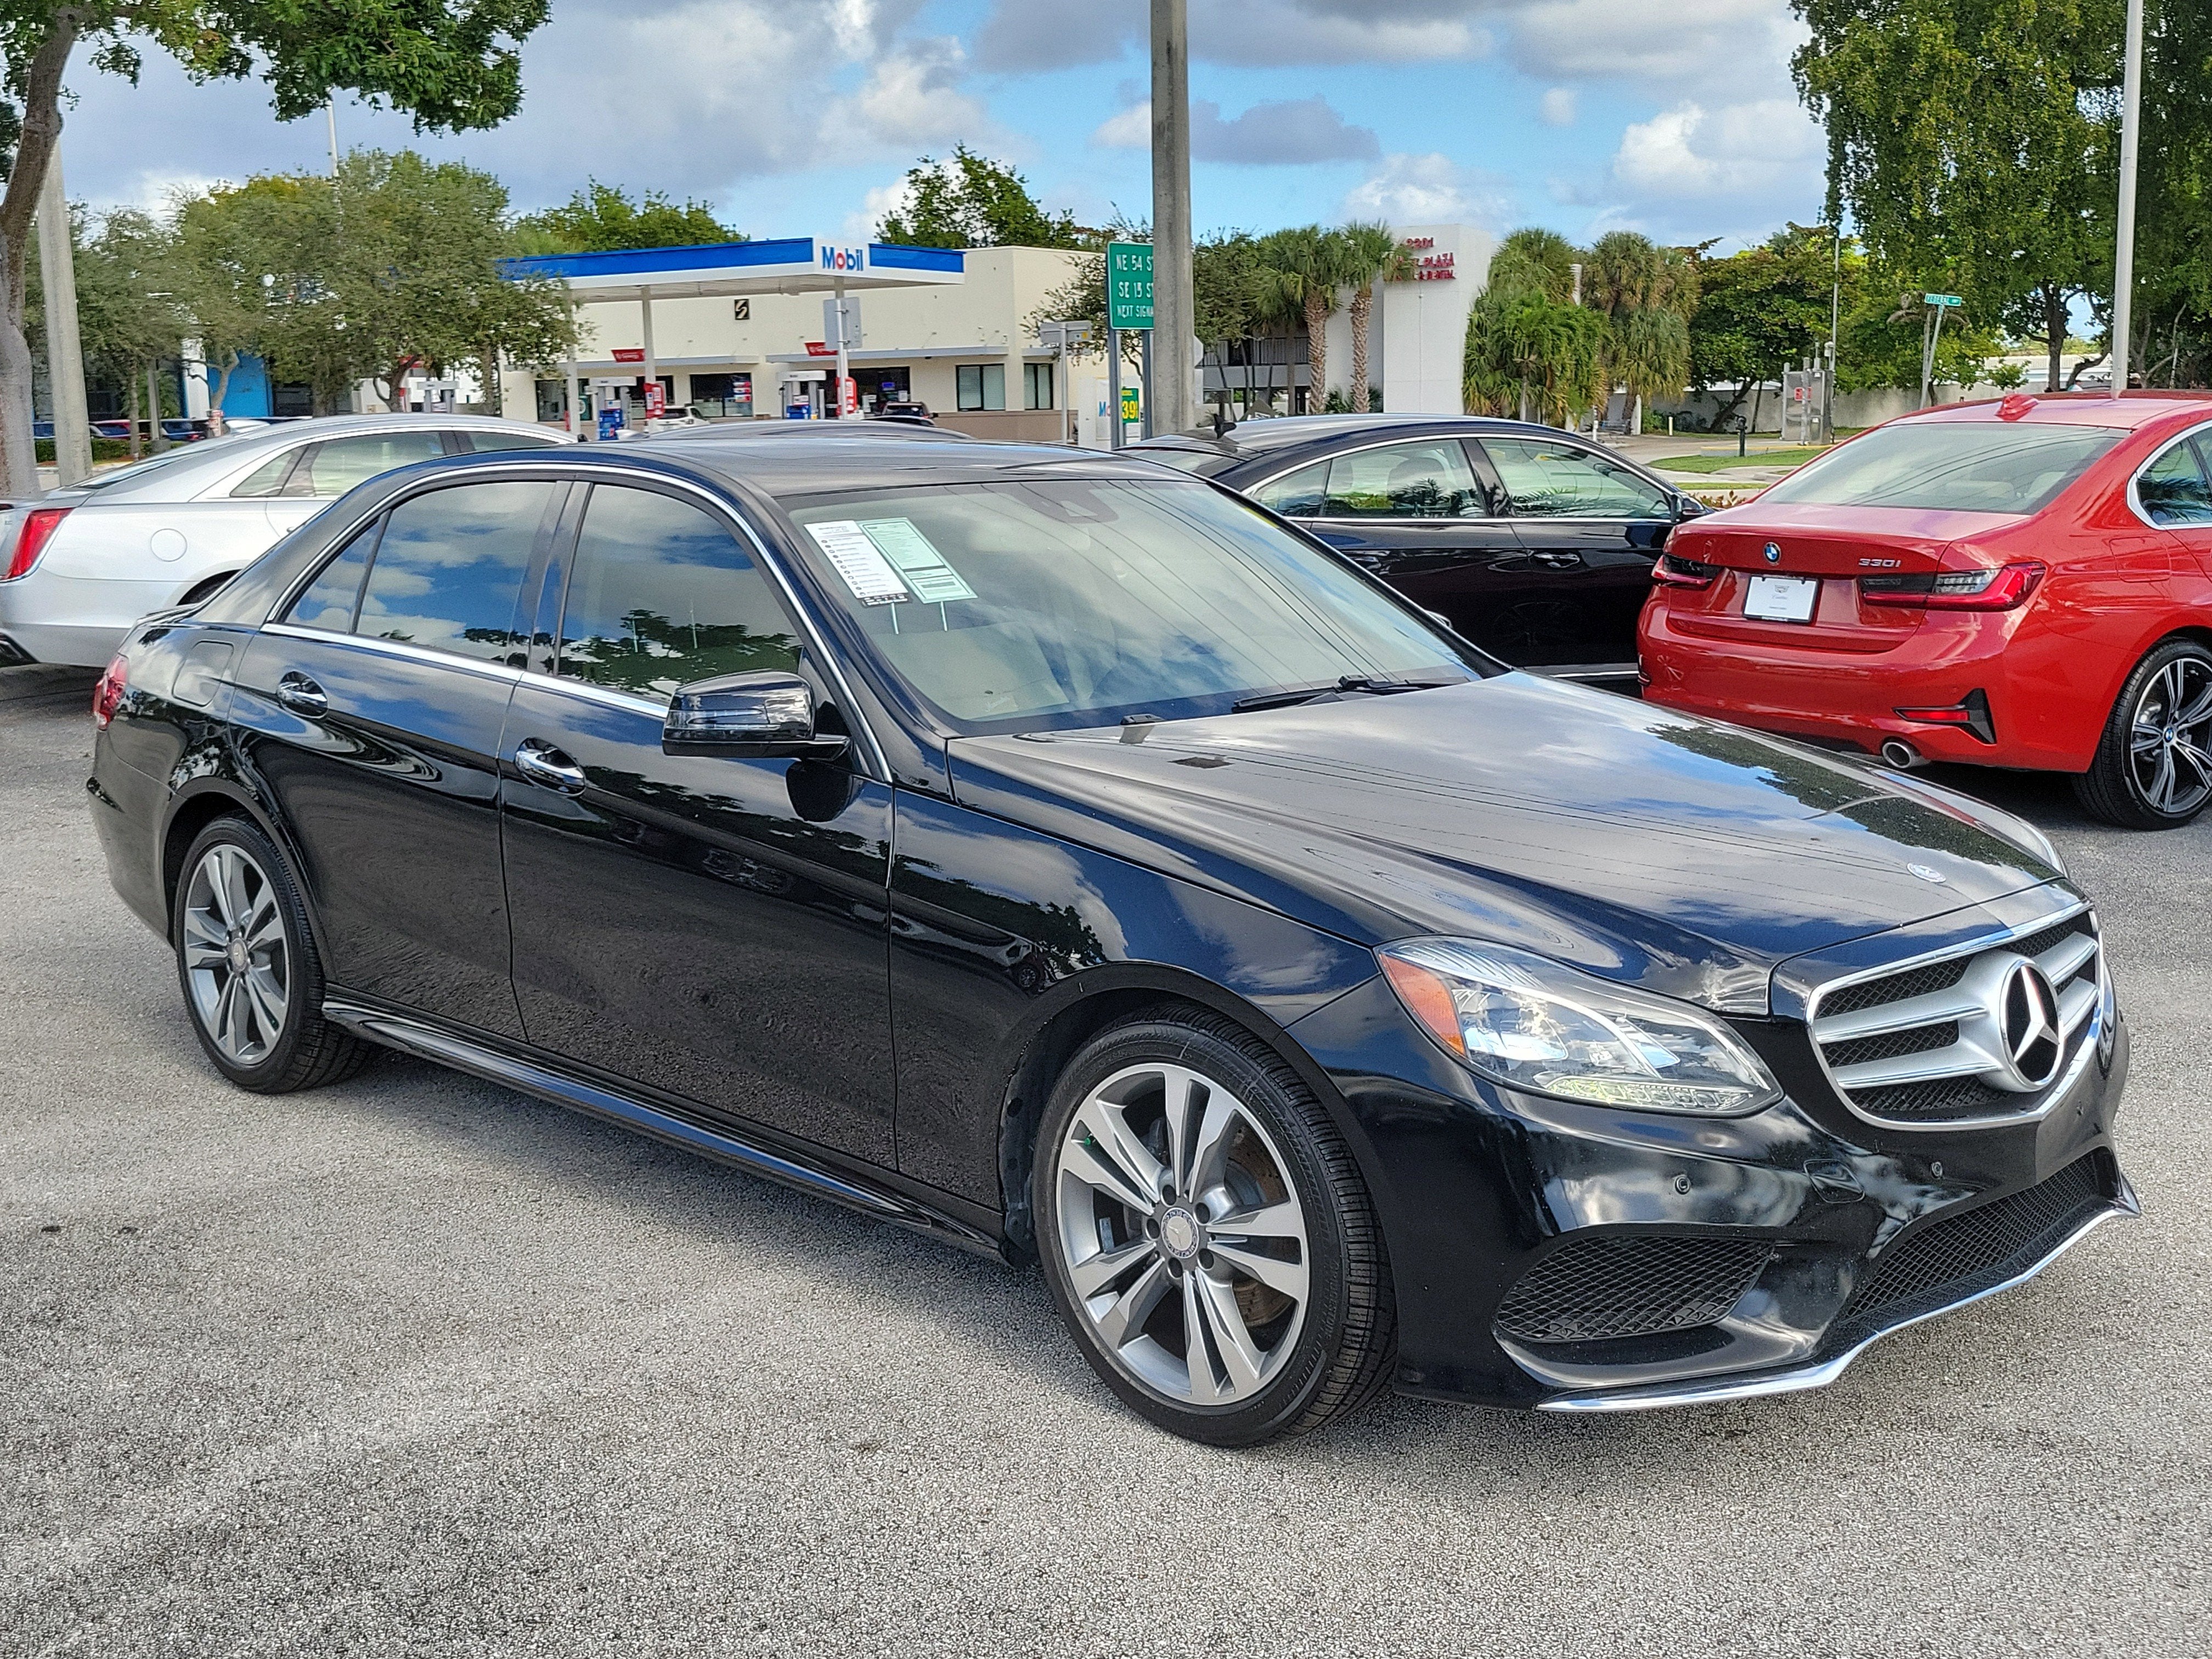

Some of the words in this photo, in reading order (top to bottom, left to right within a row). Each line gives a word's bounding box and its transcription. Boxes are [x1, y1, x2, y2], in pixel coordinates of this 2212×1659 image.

[822, 246, 864, 271] Mobil
[1116, 255, 1127, 270] NE
[1131, 255, 1142, 271] 54
[1119, 281, 1129, 298] SE
[1117, 305, 1133, 318] NEXT
[1136, 306, 1153, 317] SIGNA
